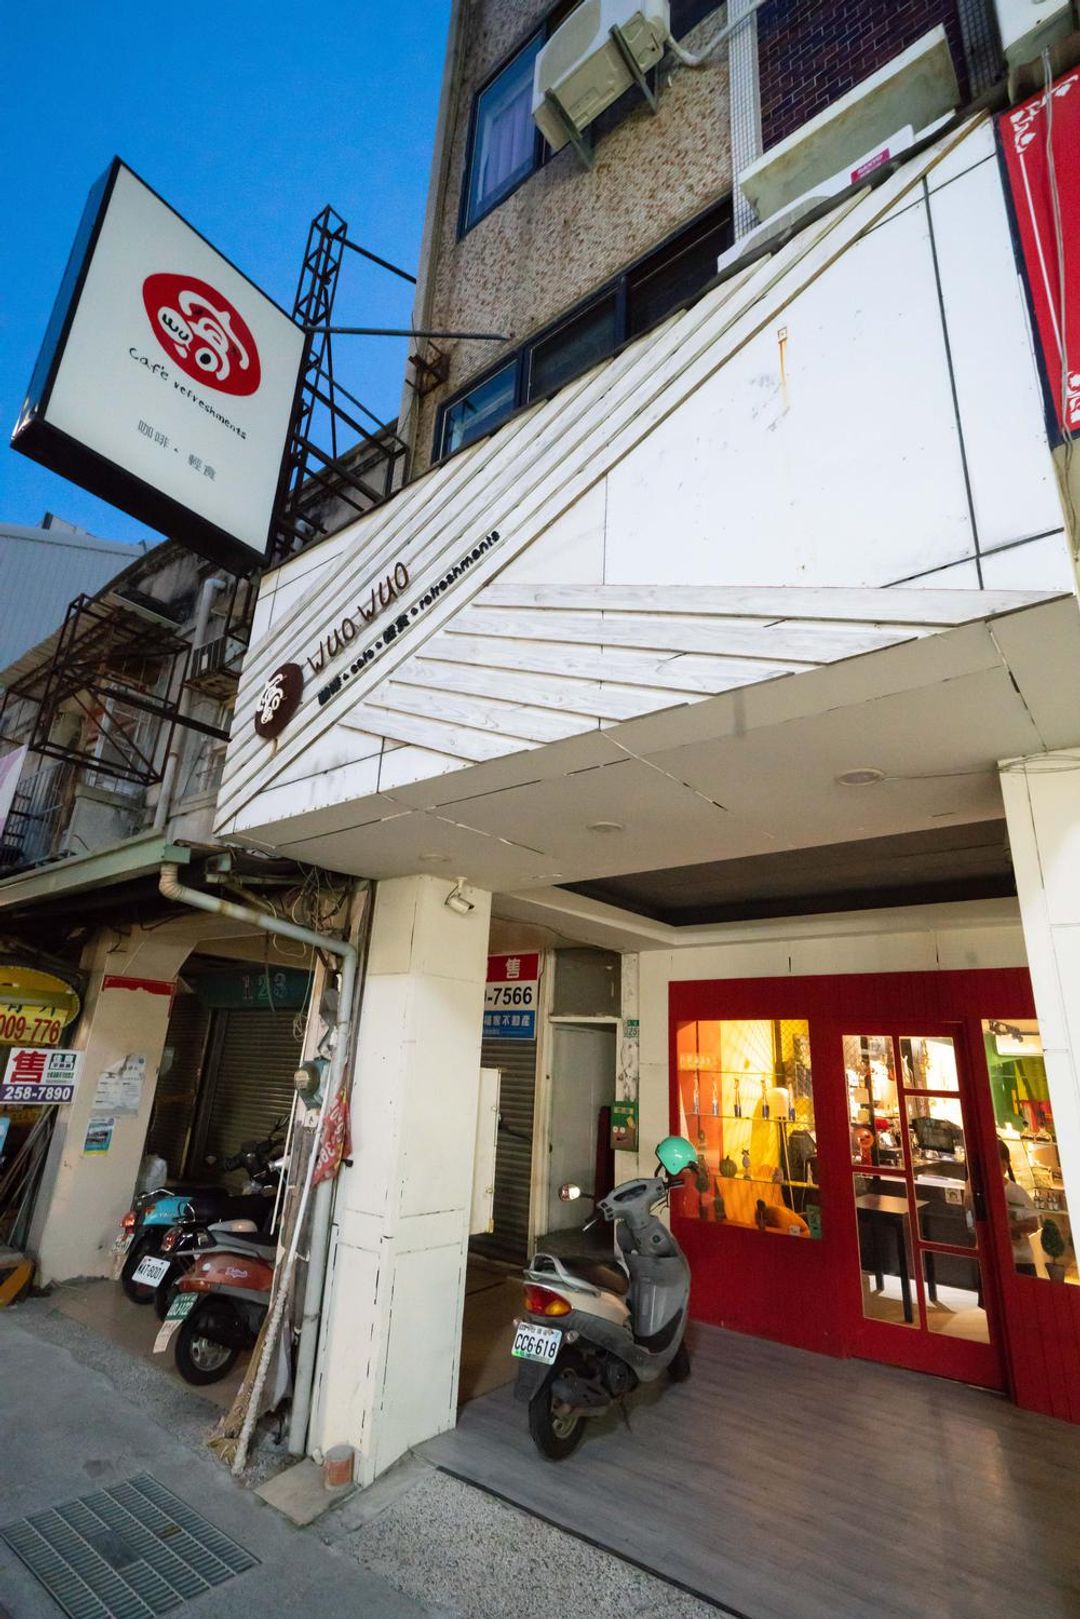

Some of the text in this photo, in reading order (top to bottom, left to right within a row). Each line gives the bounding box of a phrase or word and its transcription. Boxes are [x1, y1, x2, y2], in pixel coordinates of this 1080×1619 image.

[173, 381, 247, 440] refreshments
[138, 419, 169, 448] 咖啡
[419, 530, 501, 610] refreshments
[505, 956, 521, 979] 售
[484, 986, 533, 1006] -7566
[10, 1050, 48, 1084] 售
[3, 1086, 71, 1101] 258-7890
[515, 1333, 557, 1358] CC6-618
